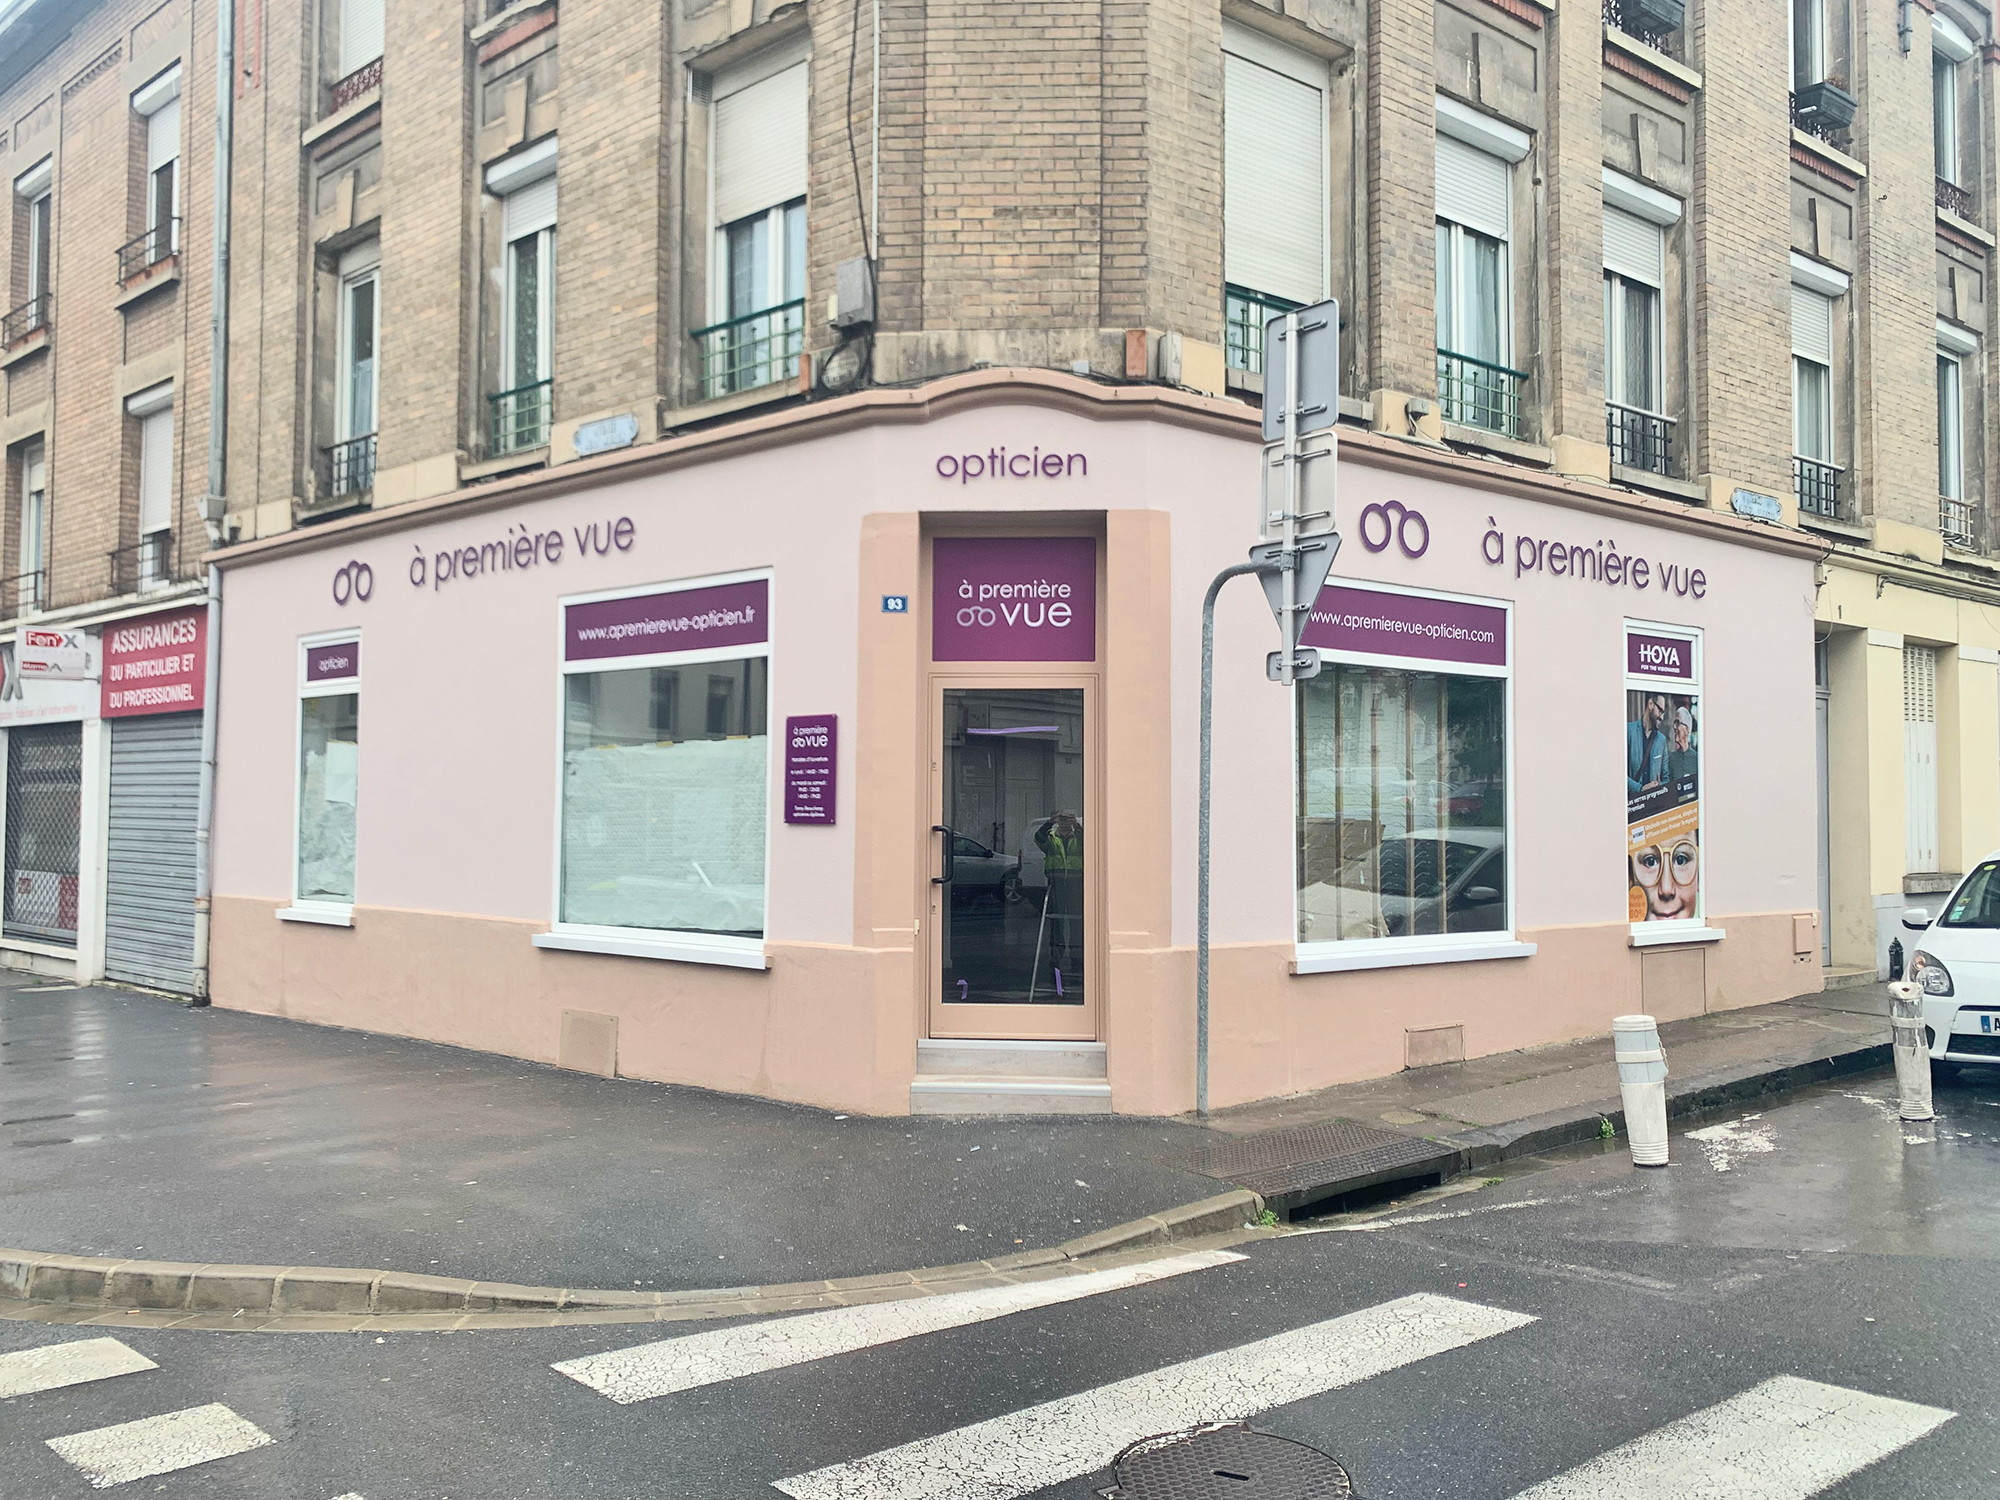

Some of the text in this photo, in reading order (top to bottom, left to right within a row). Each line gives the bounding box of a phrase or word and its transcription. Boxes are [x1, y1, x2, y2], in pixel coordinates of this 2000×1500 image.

[936, 446, 1088, 484] opticien
[409, 515, 636, 591] à première vue
[1481, 515, 1708, 600] à première vue
[958, 579, 1071, 602] à première
[111, 618, 197, 655] ASSURANCES
[577, 604, 756, 641] www.apremierevue-opticien.fr
[1310, 611, 1495, 643] www.apremierevue-opticien.com
[109, 653, 196, 682] DU PARTICULIER ET
[317, 655, 349, 673] opticien
[1638, 643, 1680, 666] HOYA
[108, 683, 195, 709] DU PROFESSIONNEL
